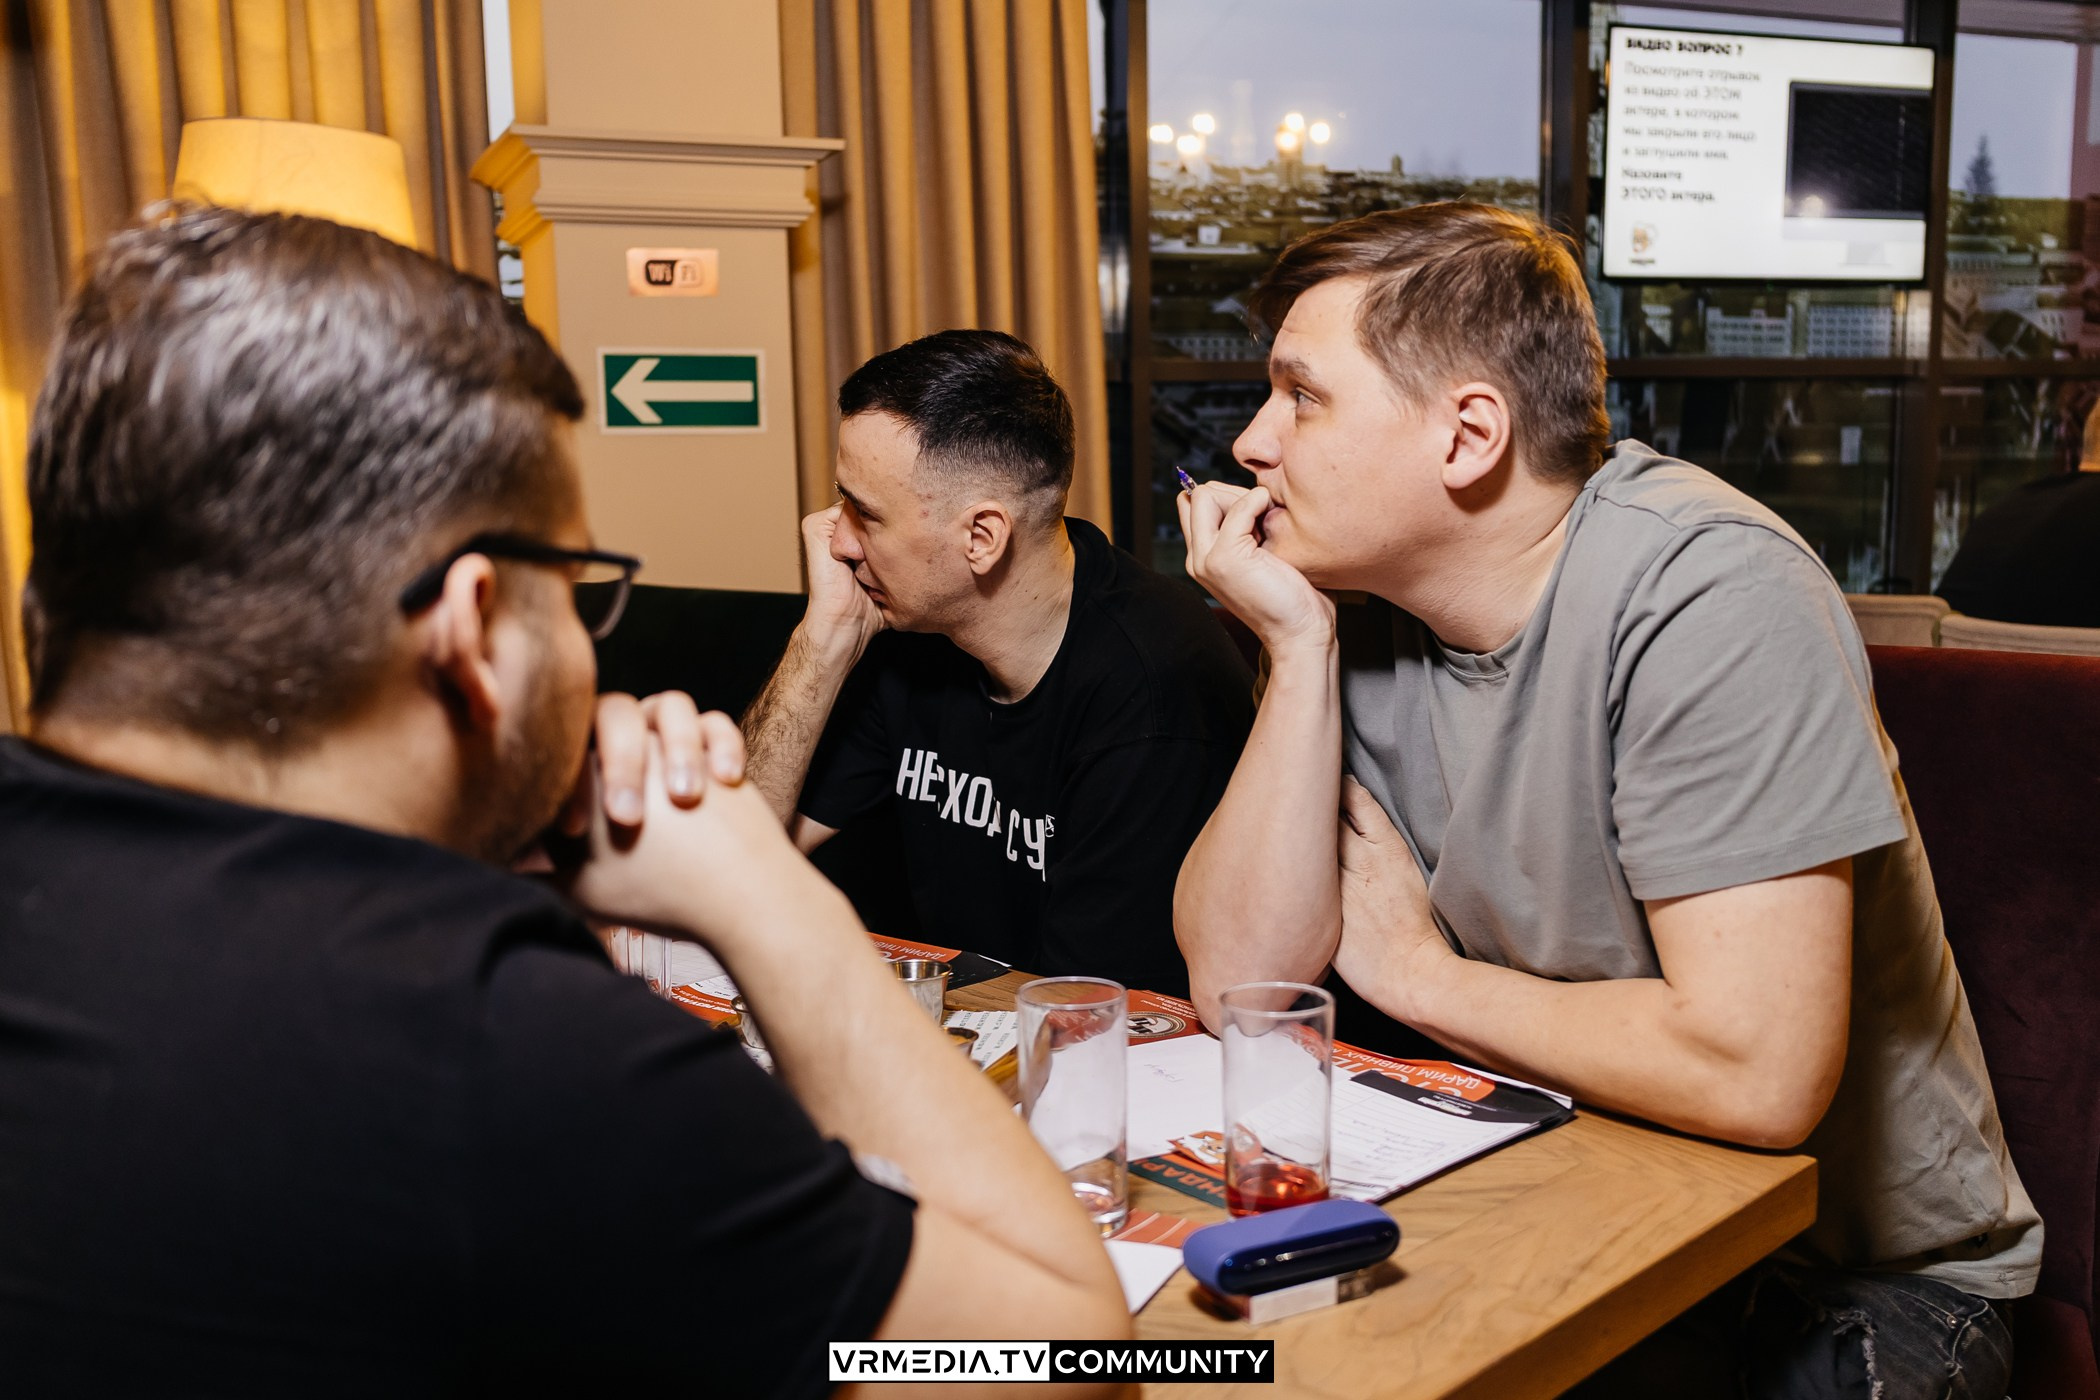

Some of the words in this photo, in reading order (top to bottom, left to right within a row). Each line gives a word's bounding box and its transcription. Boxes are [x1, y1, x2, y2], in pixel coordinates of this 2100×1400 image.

[1626, 36, 1673, 52] ВИДЕО
[1678, 39, 1732, 55] ВОПРОС
[1344, 1050, 1417, 1074] ПИВНЫХ
[1416, 1067, 1483, 1090] ДАРИМ
